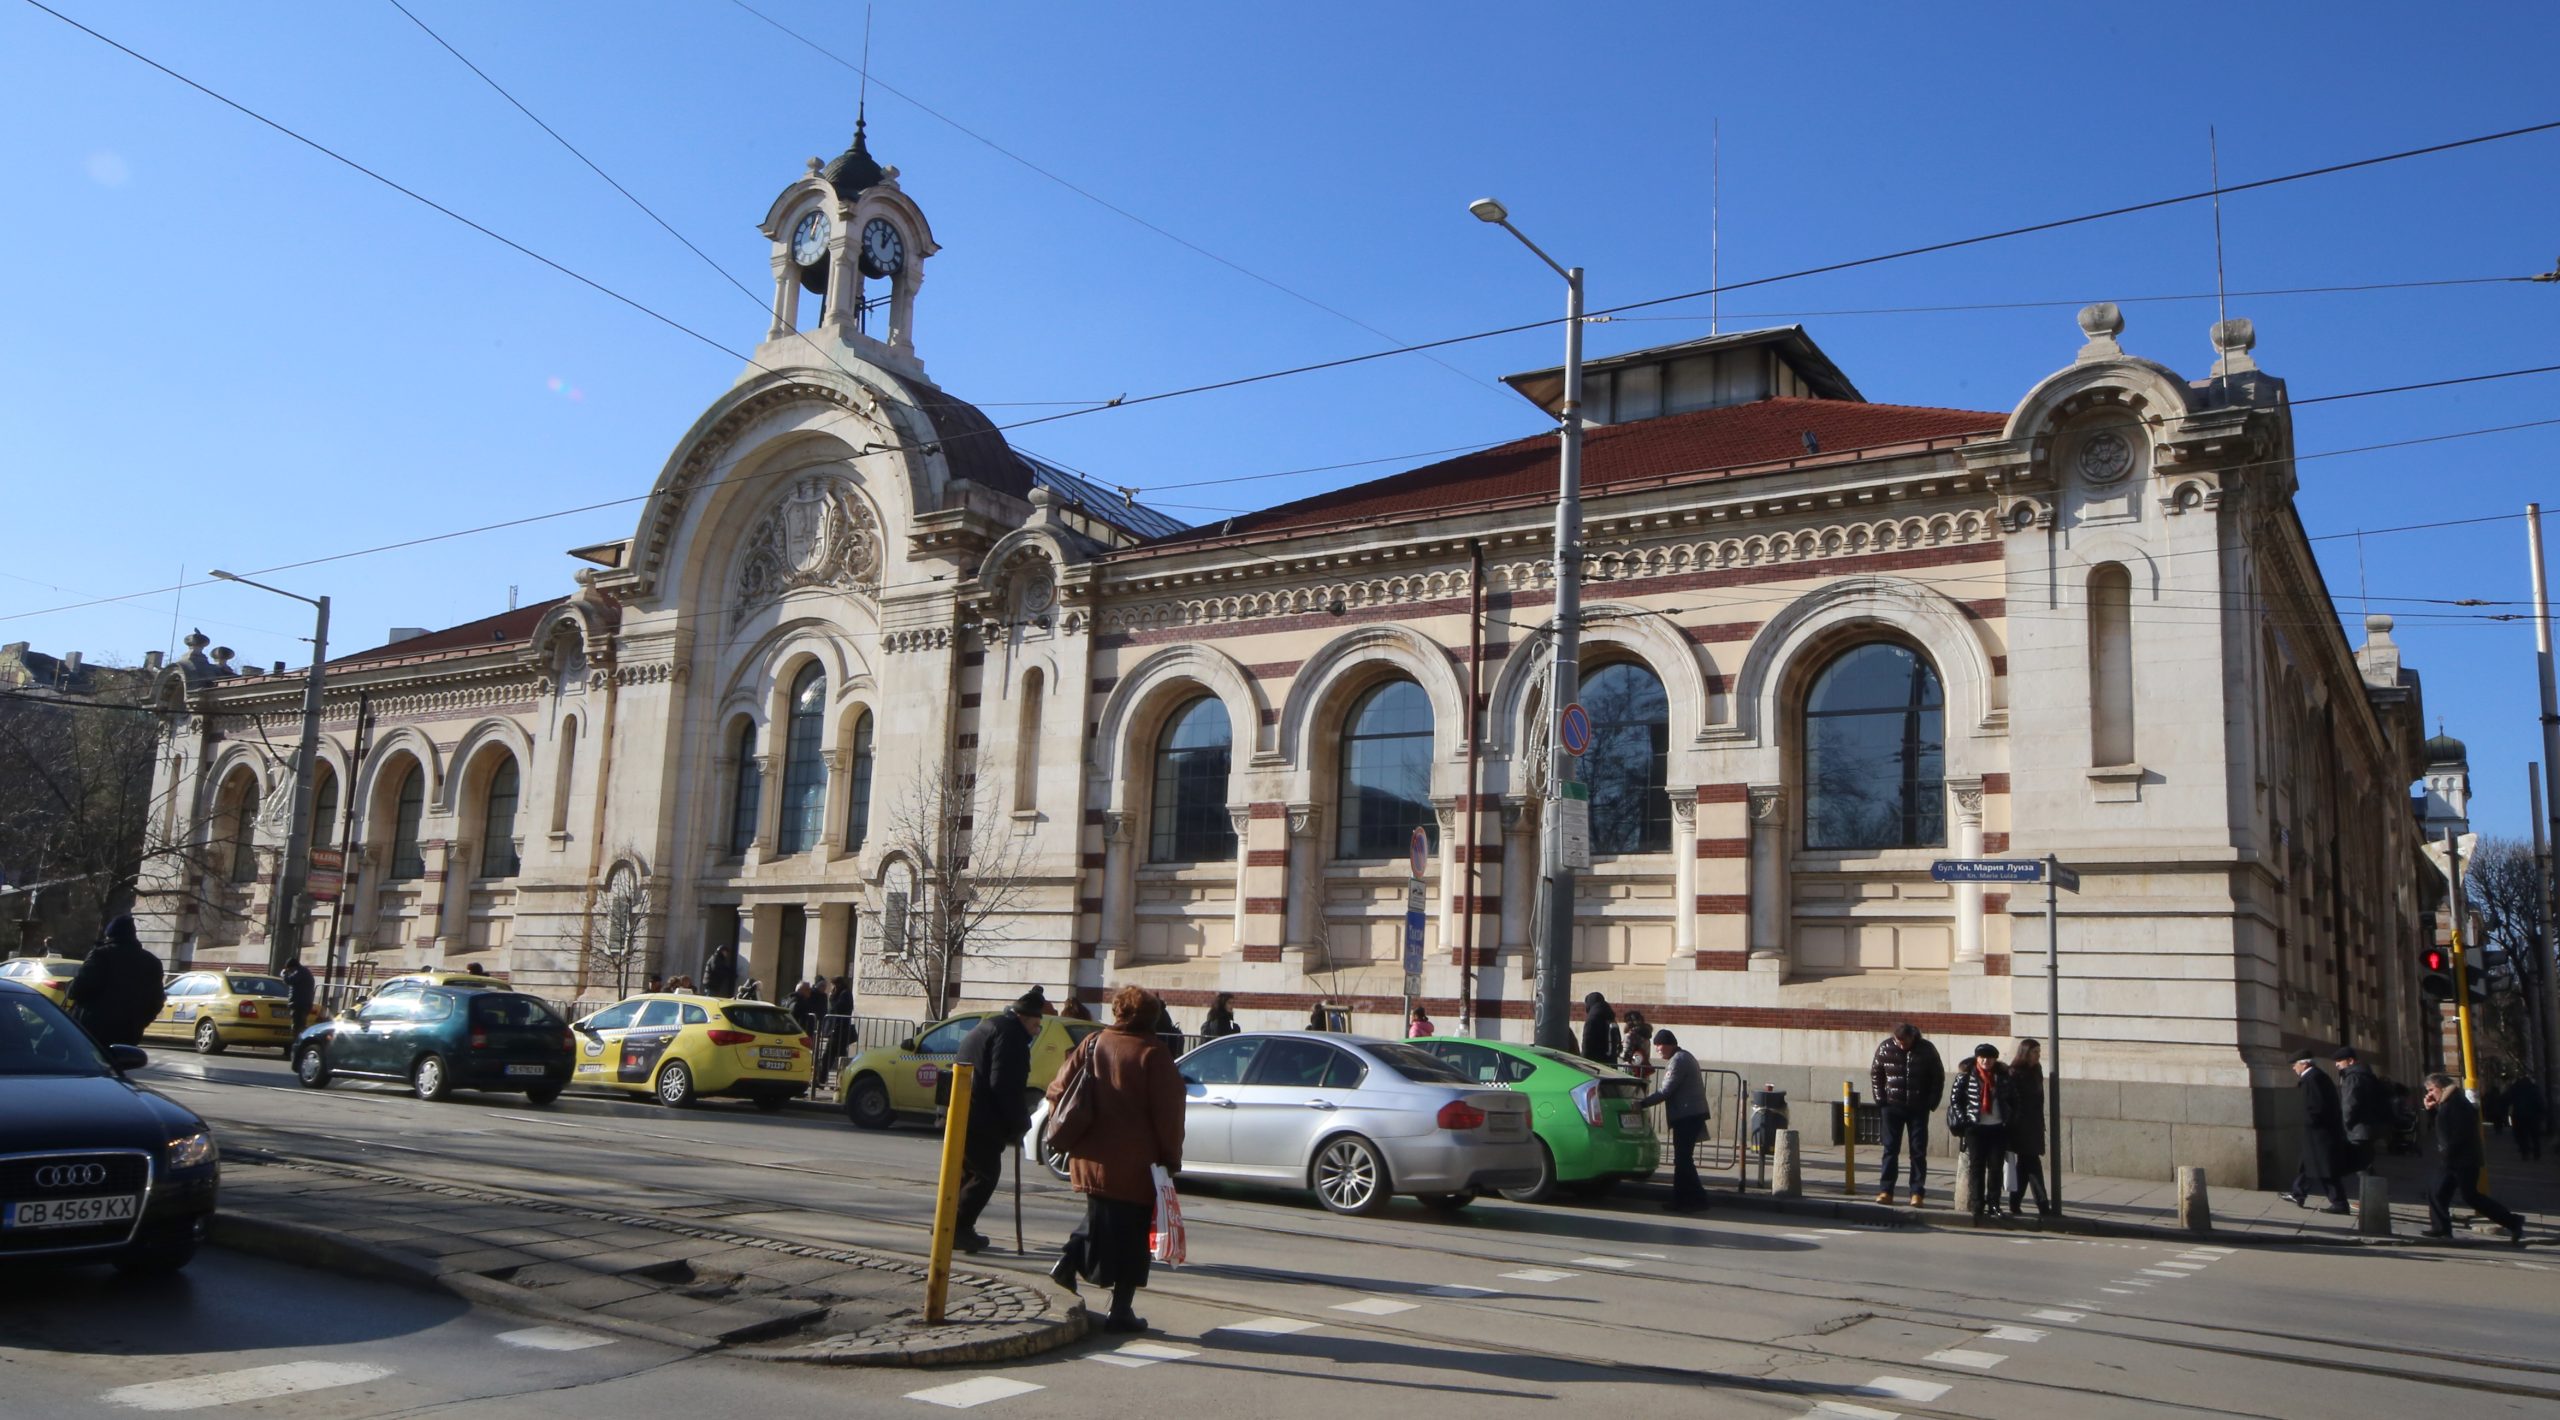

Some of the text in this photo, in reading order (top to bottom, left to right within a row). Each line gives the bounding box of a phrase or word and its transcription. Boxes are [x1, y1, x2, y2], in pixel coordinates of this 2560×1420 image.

[1938, 863, 2034, 873] бул. Кн. Мария Луиза
[19, 1197, 133, 1224] CB 4569 KX
